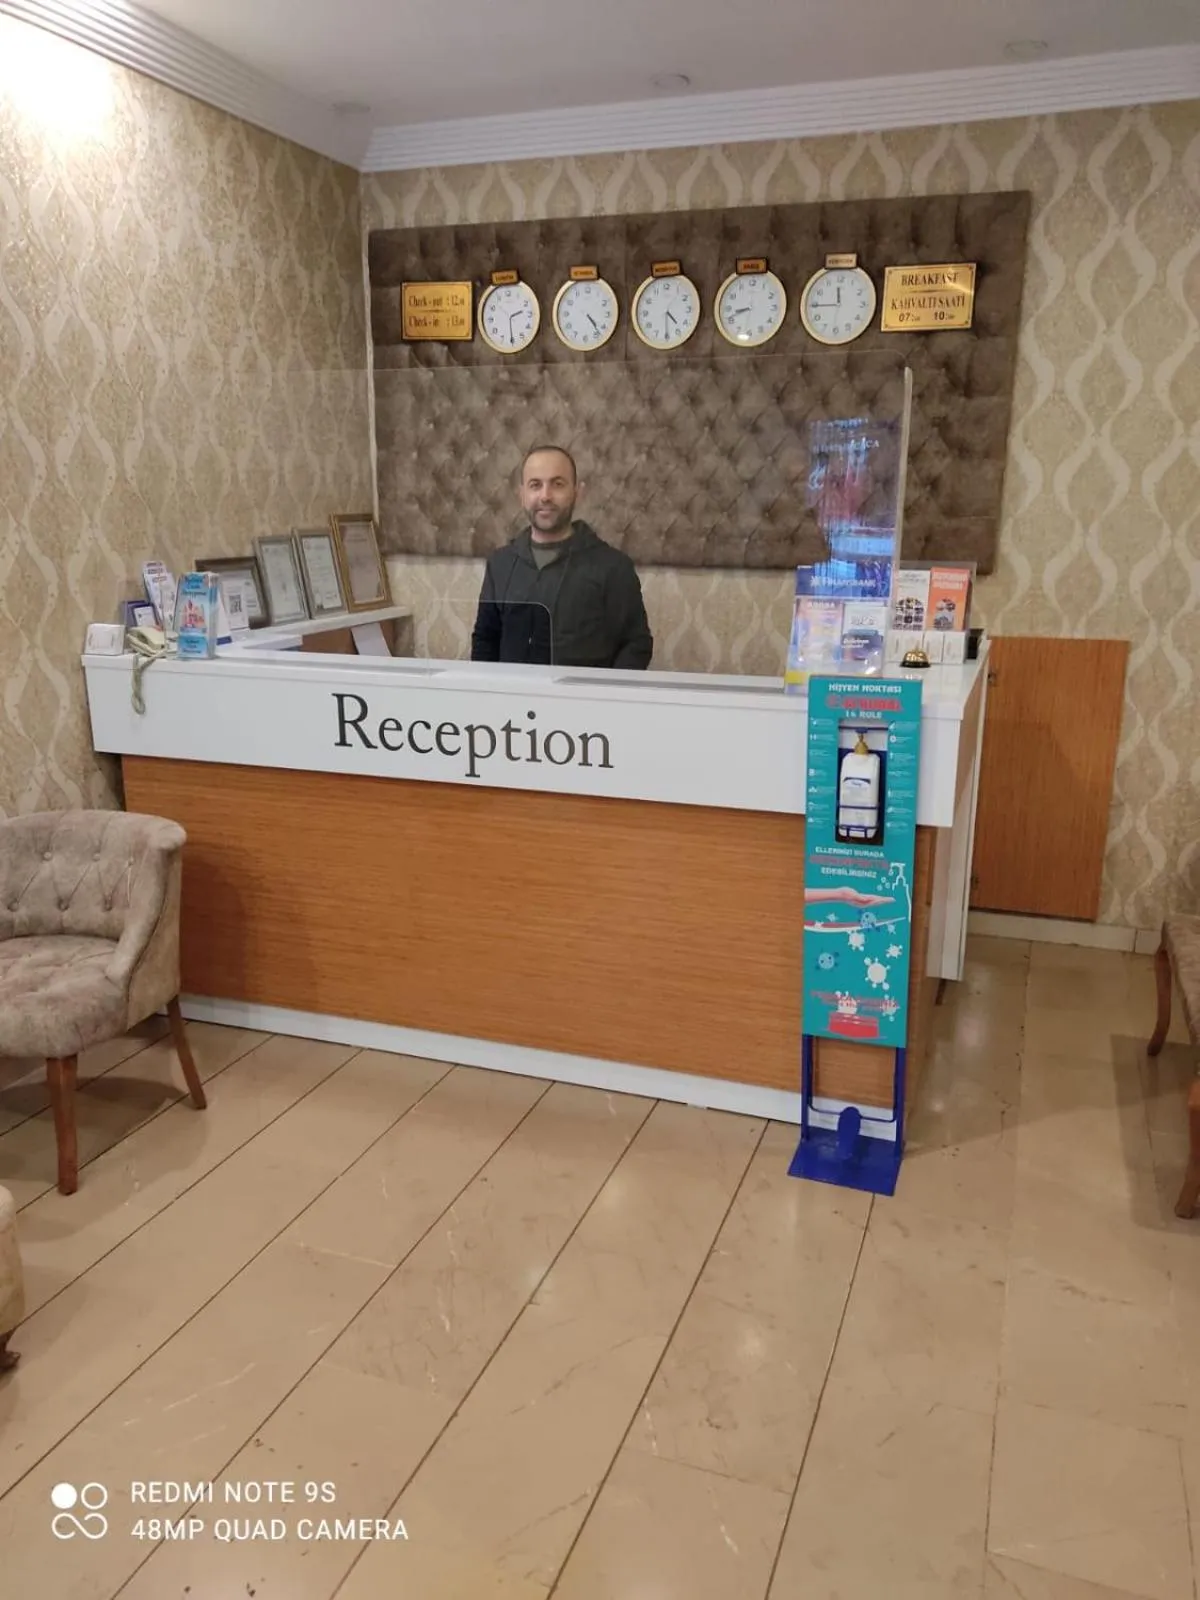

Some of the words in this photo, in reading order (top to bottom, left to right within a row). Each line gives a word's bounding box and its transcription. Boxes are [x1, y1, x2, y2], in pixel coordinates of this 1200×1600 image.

[901, 272, 959, 286] BREAKFAST
[891, 297, 936, 310] KAHVALTI
[331, 693, 614, 778] Reception
